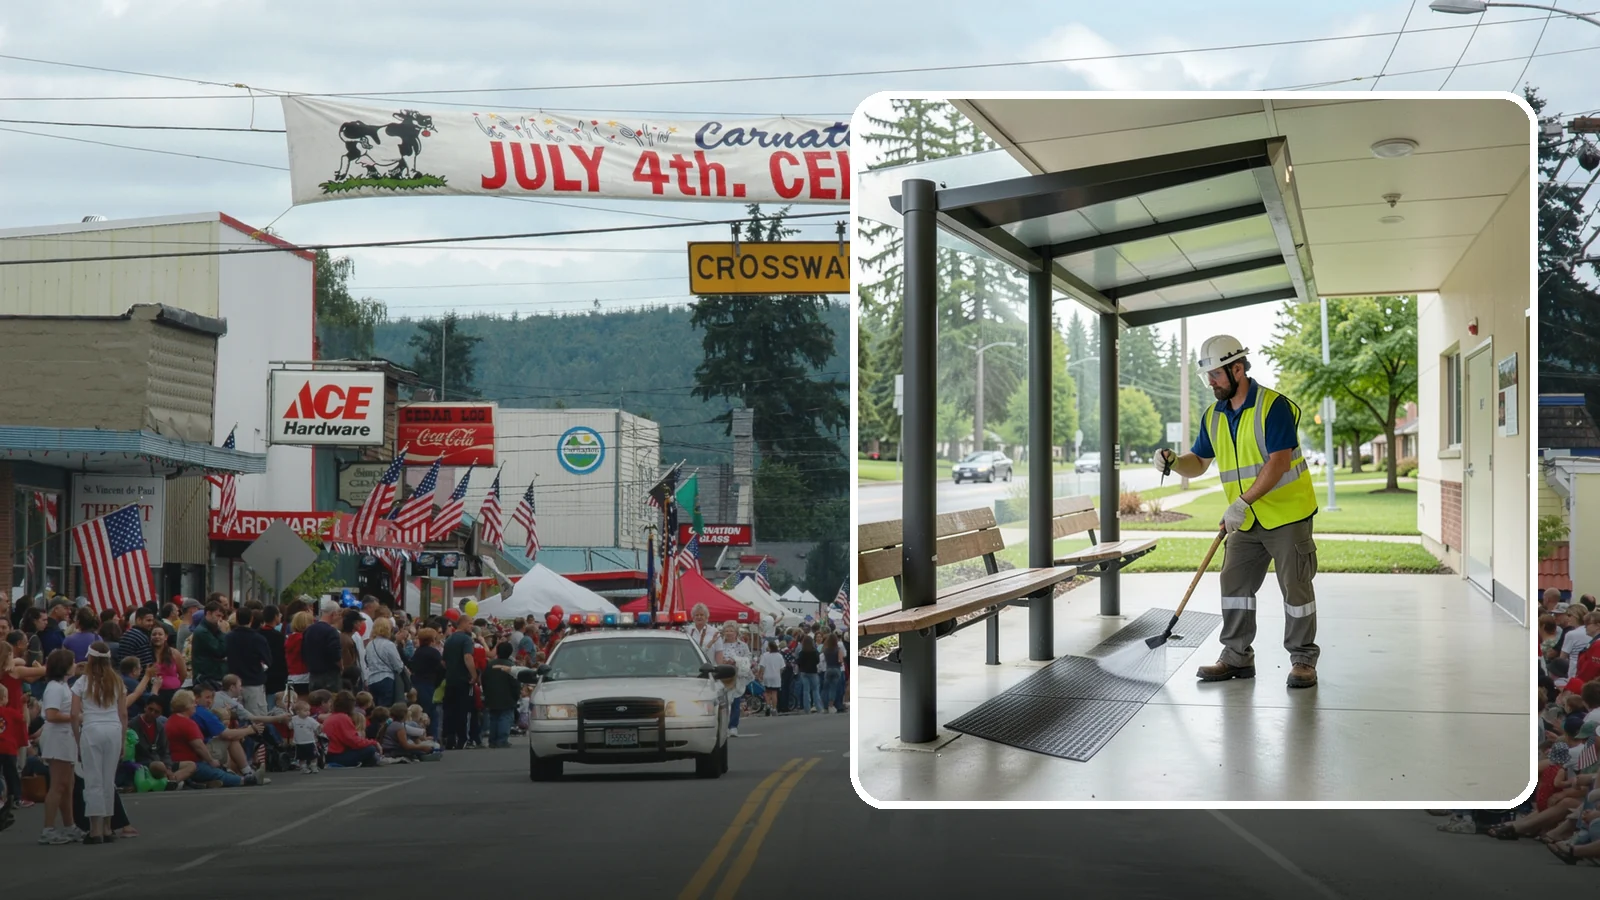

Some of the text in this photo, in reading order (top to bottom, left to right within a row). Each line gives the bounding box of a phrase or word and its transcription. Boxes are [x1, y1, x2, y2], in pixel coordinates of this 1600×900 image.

[481, 141, 605, 193] JULY
[632, 150, 747, 199] 4th.
[697, 254, 850, 280] CROSSWA
[282, 380, 373, 420] ACE
[406, 409, 485, 421] CEDAR LOG
[283, 421, 371, 436] Hardware
[416, 428, 477, 447] Coca-Cola
[353, 467, 385, 481] Simpl
[95, 485, 124, 494] Vincent
[126, 485, 136, 495] de
[137, 486, 155, 495] Paul
[688, 526, 741, 535] CRNATION
[699, 535, 730, 543] GLASS
